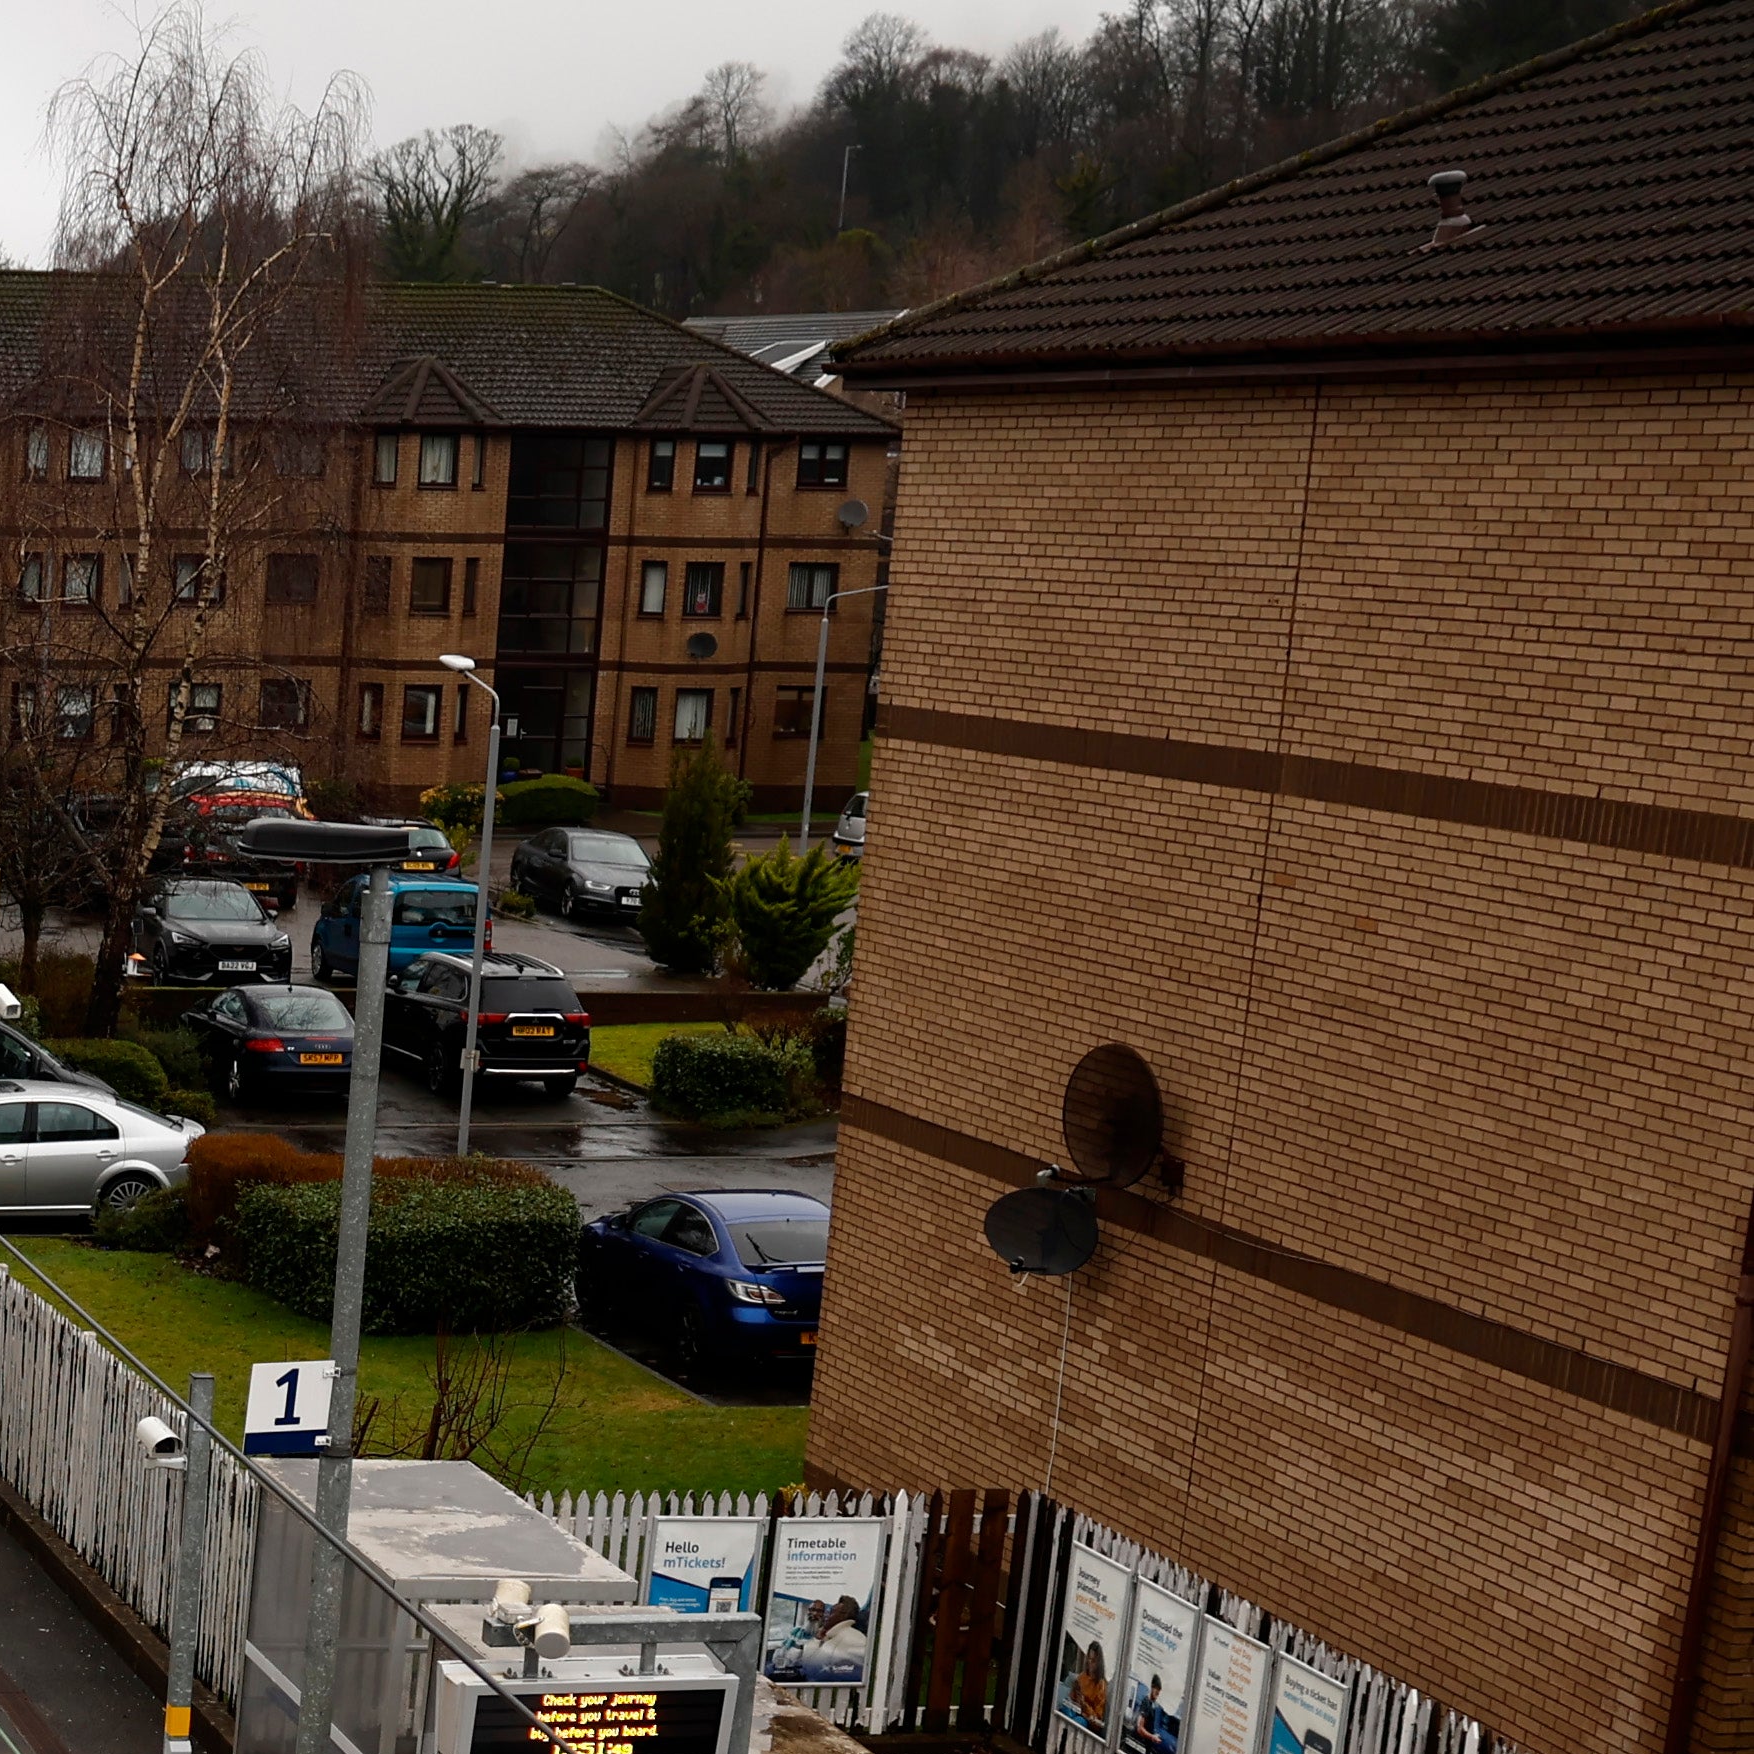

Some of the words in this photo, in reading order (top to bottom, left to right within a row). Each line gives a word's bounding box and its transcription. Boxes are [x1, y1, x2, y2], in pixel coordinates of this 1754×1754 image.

[274, 1368, 301, 1426] 1
[665, 1541, 700, 1554] Hello
[787, 1538, 847, 1549] Timetable
[663, 1556, 726, 1569] mTickets!
[787, 1550, 857, 1562] information
[1142, 1608, 1172, 1634] Download
[1172, 1624, 1183, 1640] the
[1165, 1637, 1178, 1652] App
[1206, 1668, 1222, 1682] Value
[1211, 1684, 1226, 1698] every
[1284, 1674, 1305, 1697] Buying
[1309, 1688, 1328, 1706] ticket
[1327, 1699, 1338, 1711] has
[543, 1694, 577, 1706] Check
[580, 1696, 607, 1708] your
[610, 1694, 657, 1707] journey
[580, 1713, 601, 1724] you
[606, 1710, 644, 1721] travel
[647, 1709, 657, 1720] &
[598, 1728, 619, 1739] you
[622, 1725, 659, 1737] board.
